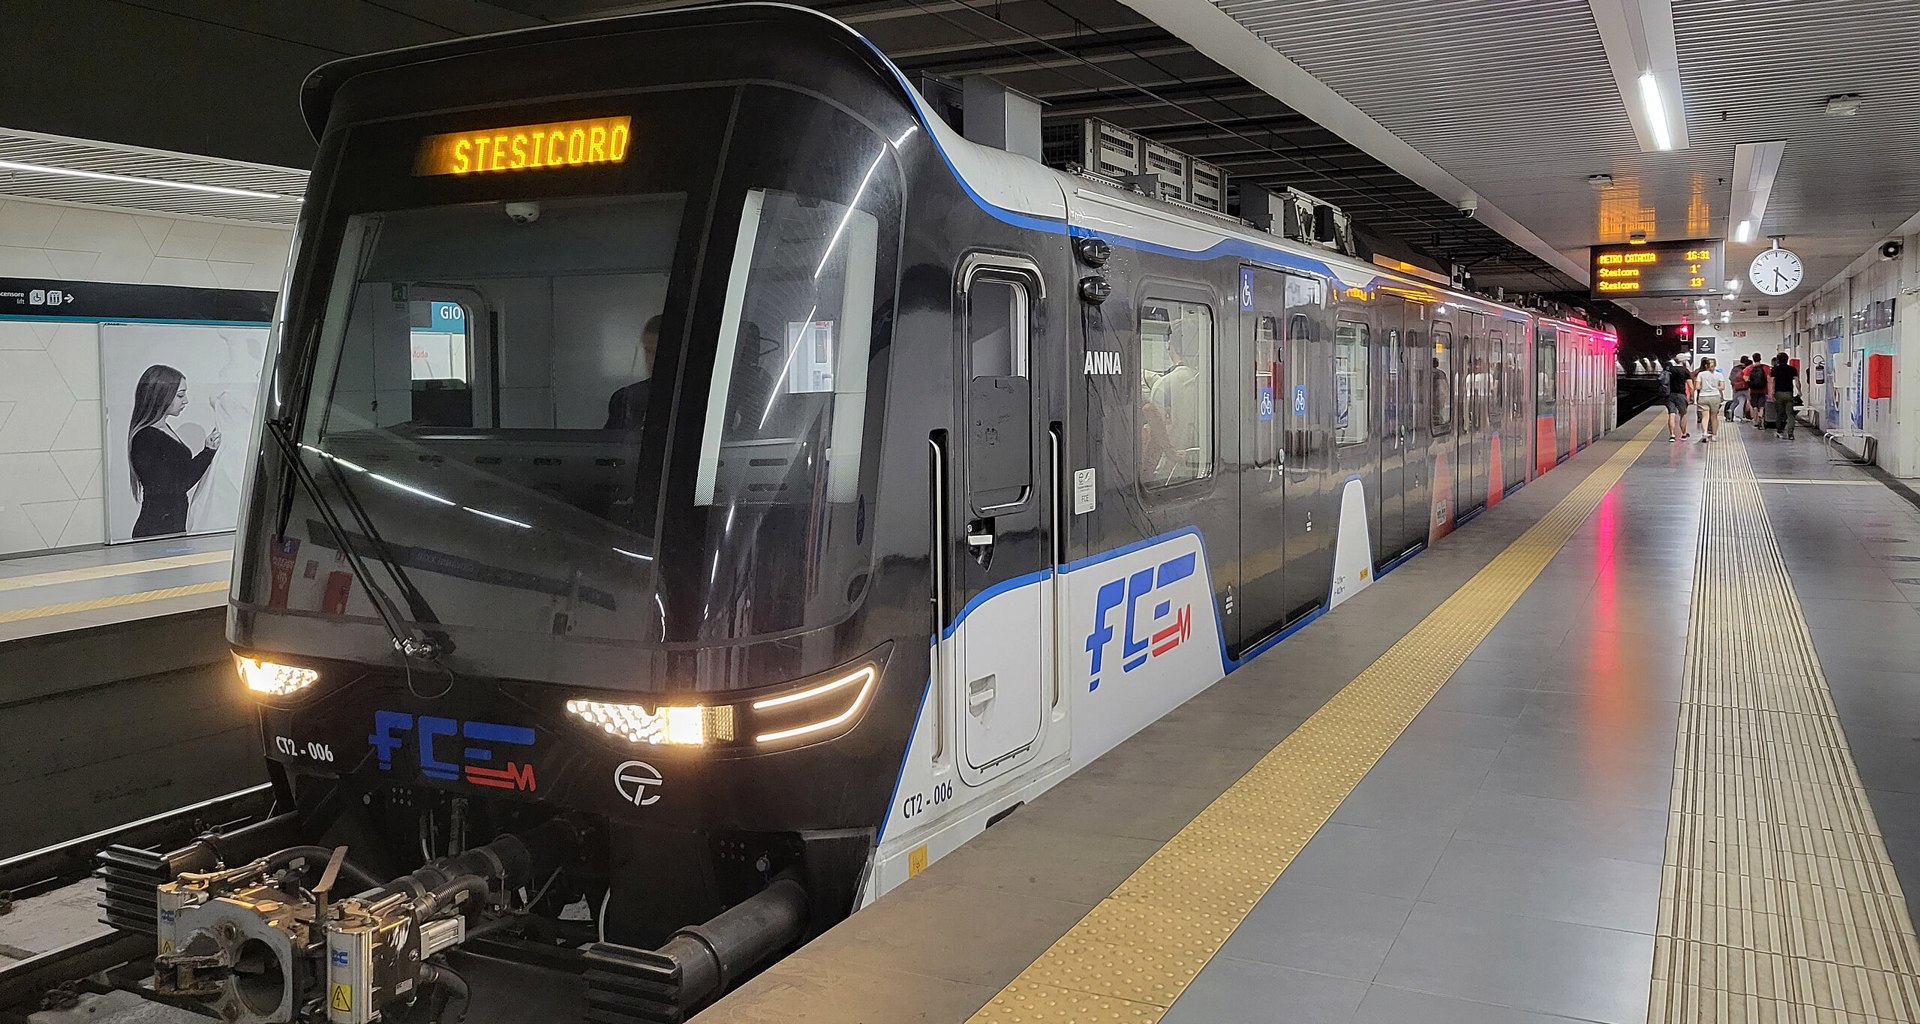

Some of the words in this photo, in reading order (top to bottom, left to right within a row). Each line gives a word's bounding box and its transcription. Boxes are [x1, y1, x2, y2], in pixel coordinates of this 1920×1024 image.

[453, 125, 628, 174] STESICORO
[1687, 250, 1710, 260] 16:31
[1600, 268, 1639, 277] Stesicoro
[1600, 281, 1639, 290] Stesicoro
[1702, 339, 1710, 348] 2
[1083, 351, 1122, 375] ANNA
[276, 736, 298, 756] CT2
[307, 742, 334, 763] 006
[903, 793, 923, 819] CT2
[934, 779, 953, 806] 006
